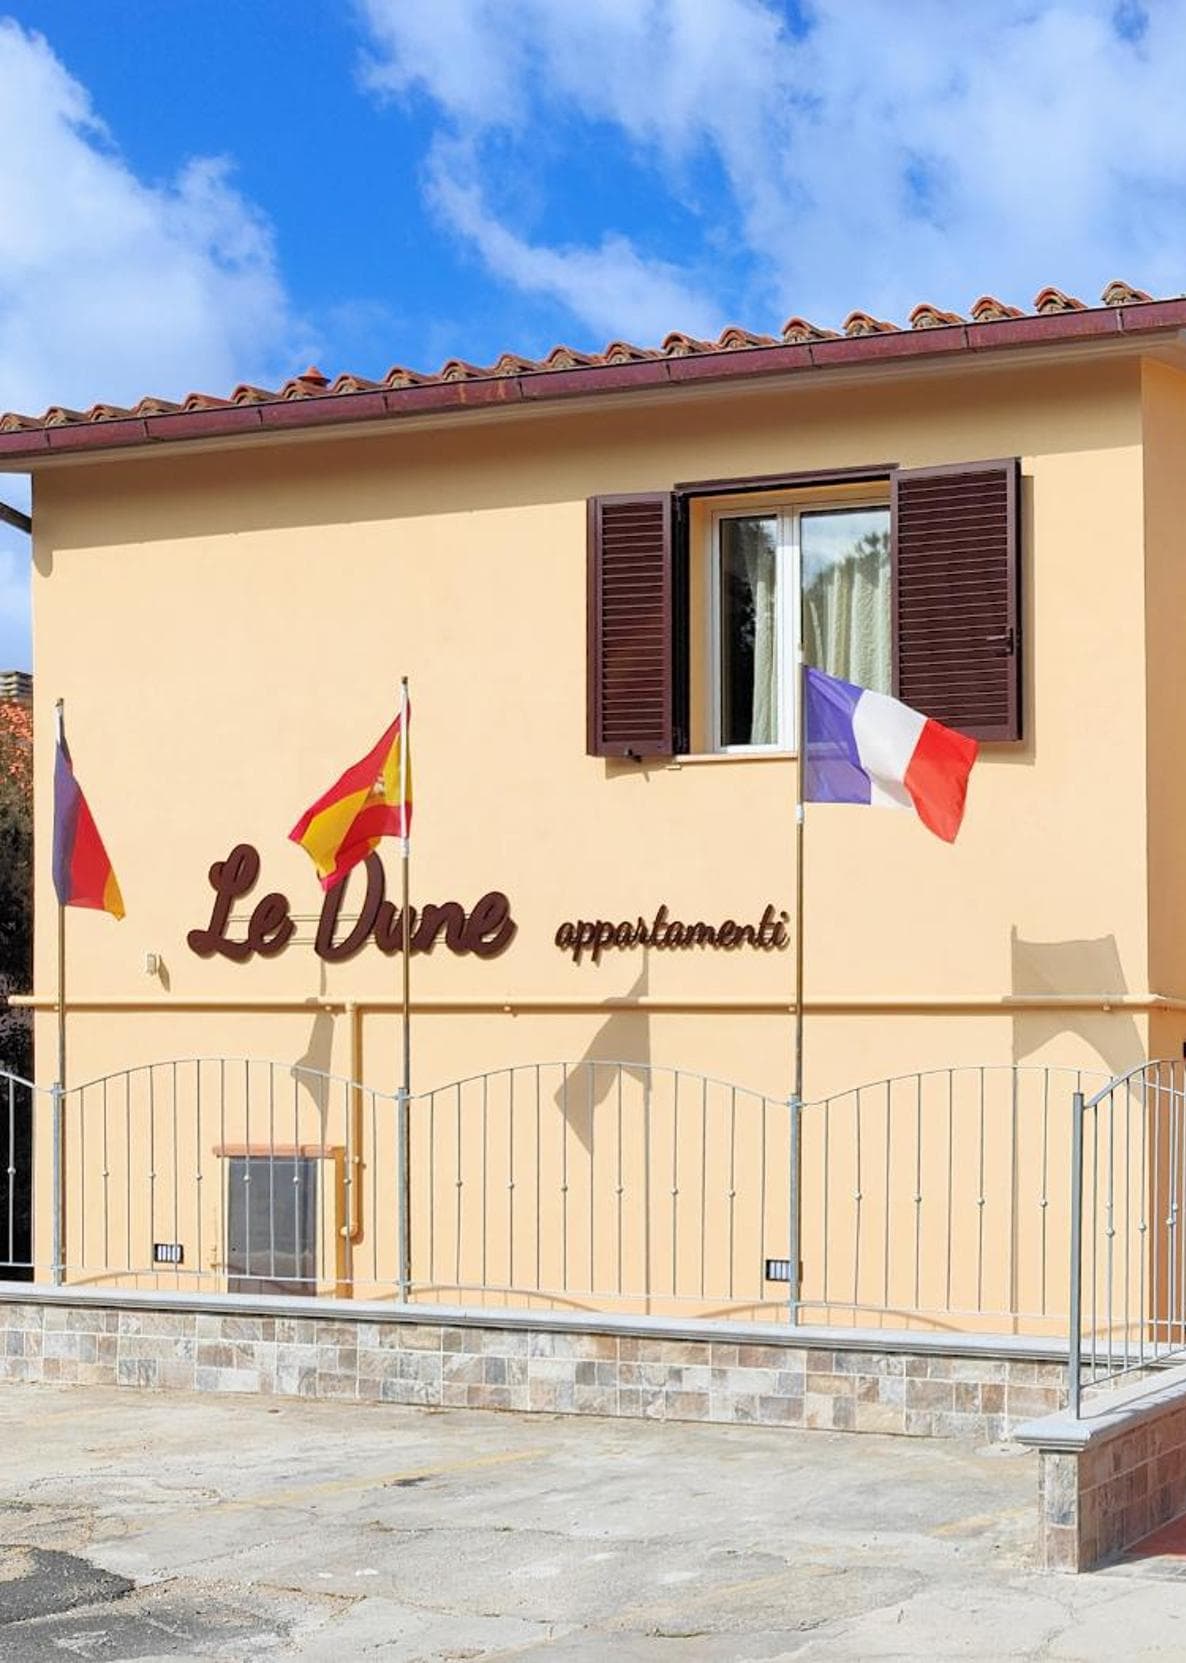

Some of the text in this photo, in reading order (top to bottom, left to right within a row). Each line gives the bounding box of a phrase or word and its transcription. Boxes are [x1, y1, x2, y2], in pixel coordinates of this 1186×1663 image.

[187, 843, 517, 962] Le Dune
[554, 904, 789, 964] appartamenti
